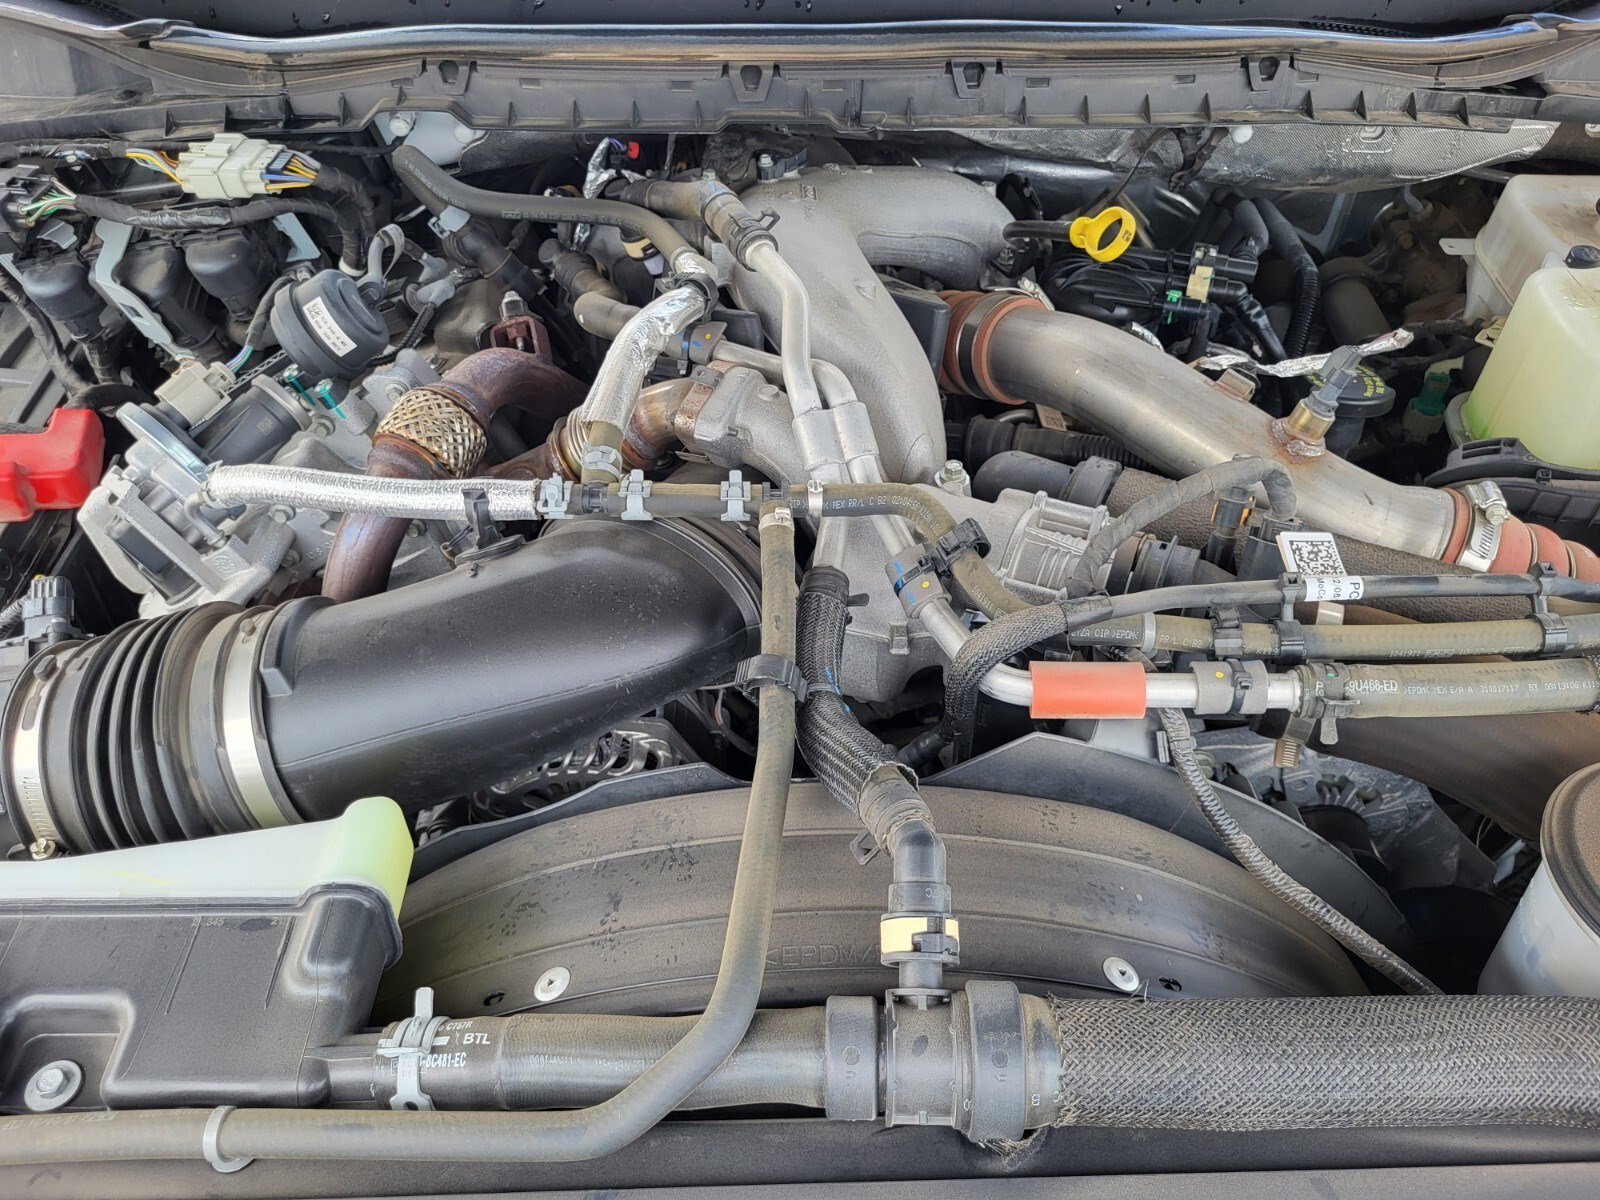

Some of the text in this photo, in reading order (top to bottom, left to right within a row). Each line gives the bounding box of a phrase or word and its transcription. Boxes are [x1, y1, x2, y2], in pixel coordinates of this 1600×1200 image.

[833, 501, 845, 509] MEX
[848, 499, 865, 507] RR/L
[1094, 629, 1110, 638] DIP
[1160, 634, 1178, 645] RR/L
[1192, 639, 1203, 648] B2
[1433, 686, 1448, 694] MEX
[1450, 686, 1464, 694] E/A
[463, 1032, 491, 1045] BTL
